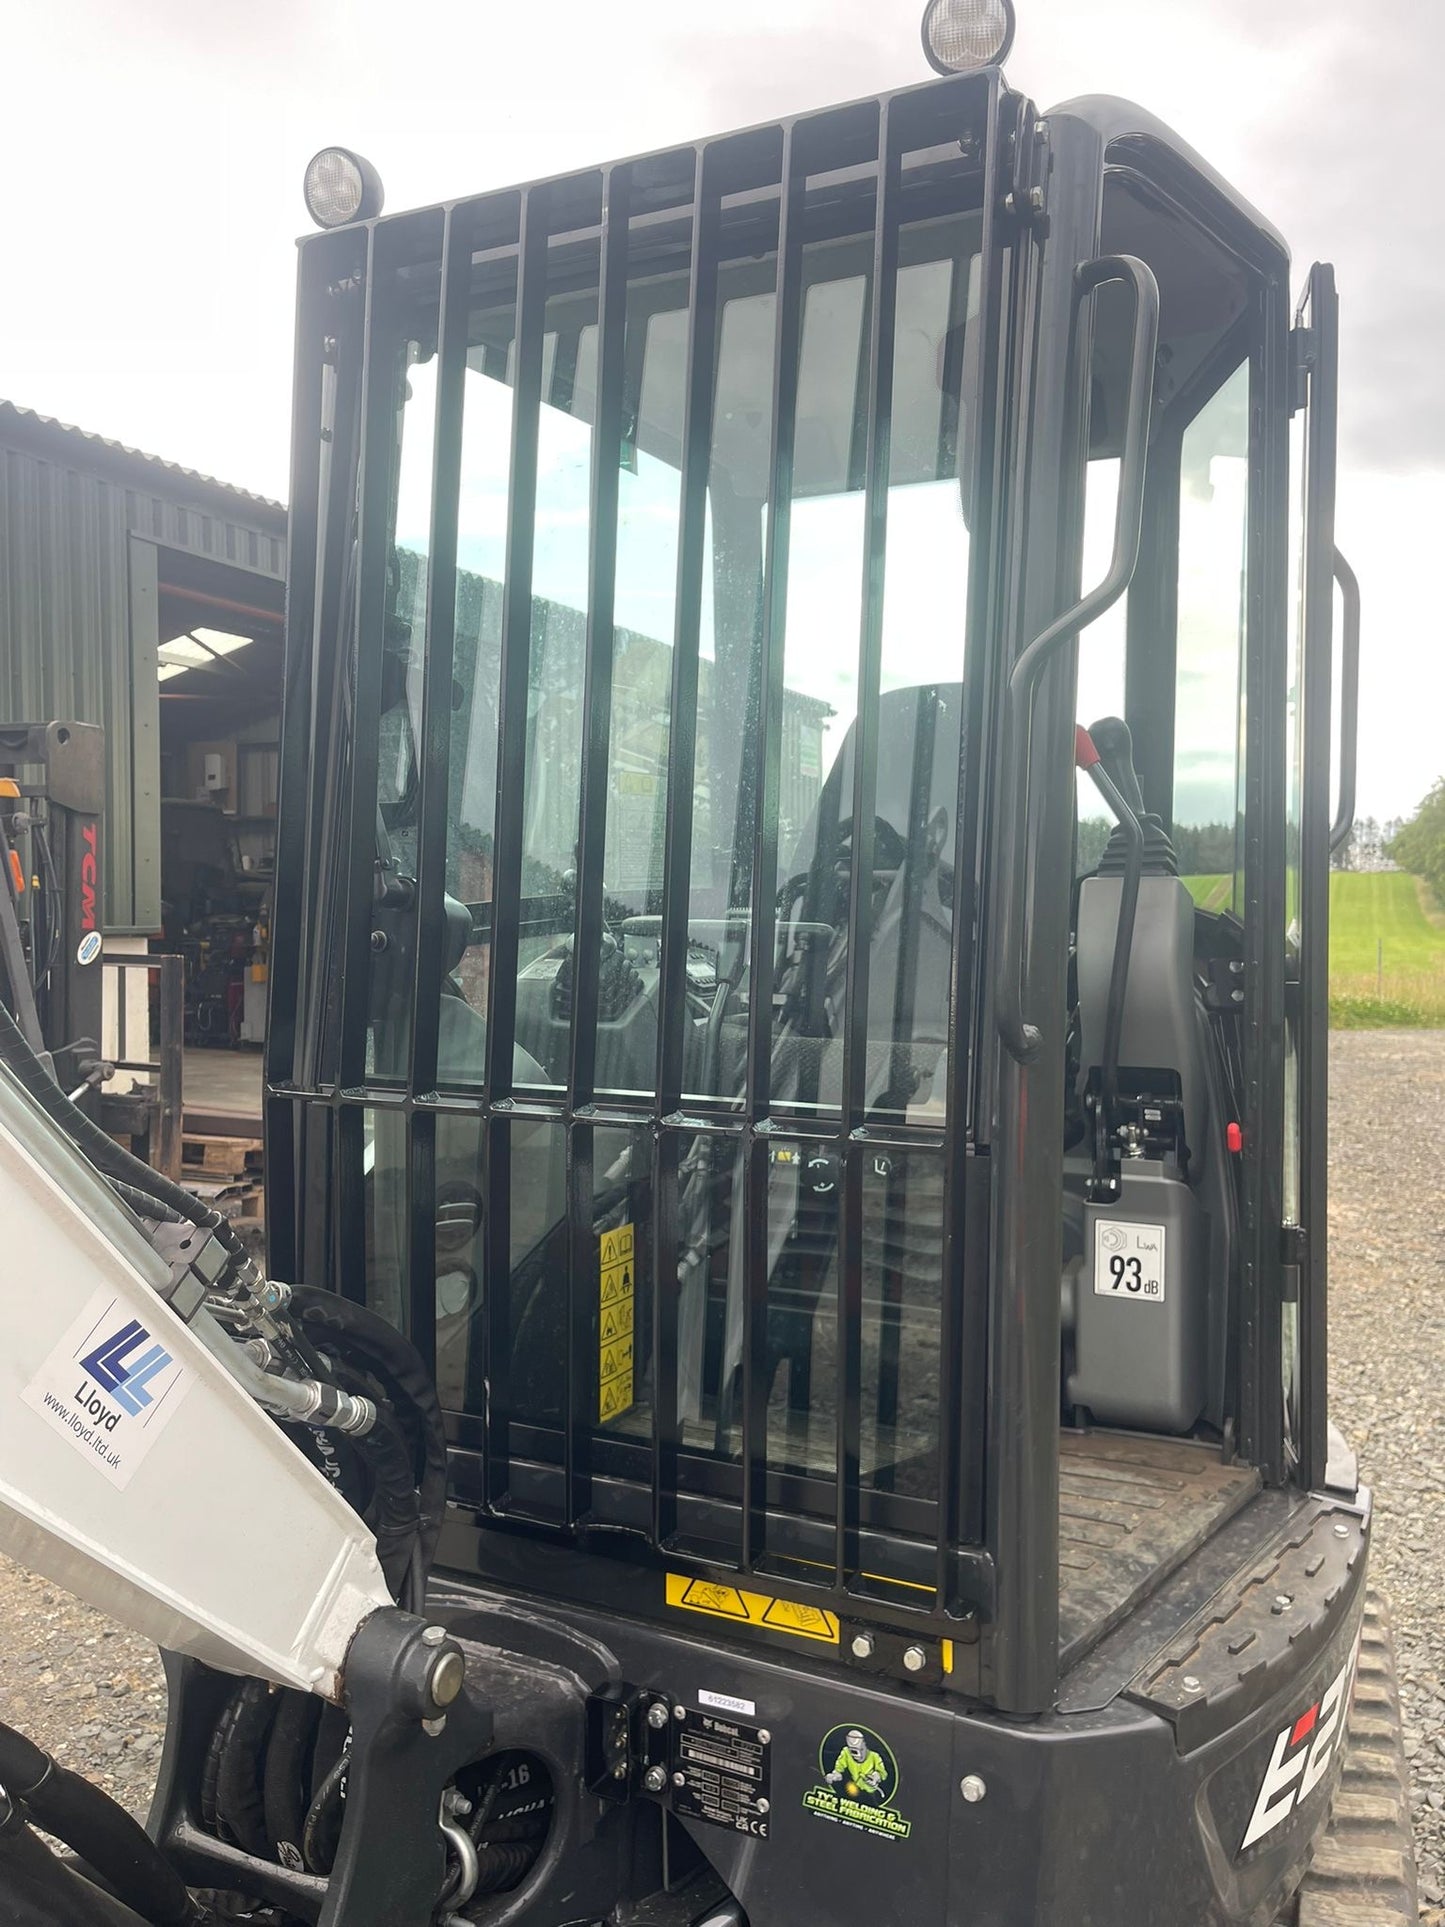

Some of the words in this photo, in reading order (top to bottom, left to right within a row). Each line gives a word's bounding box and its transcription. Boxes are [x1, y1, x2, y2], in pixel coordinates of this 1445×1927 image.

[81, 823, 96, 929] TCM
[1110, 1255, 1142, 1292] 93
[1144, 1280, 1159, 1295] dB
[74, 1381, 122, 1433] Lloyd
[43, 1392, 122, 1470] www.lloyd.ltd.uk
[750, 1821, 767, 1837] CE
[806, 1796, 838, 1812] STEEL
[839, 1807, 906, 1833] FABRICATION
[840, 1798, 886, 1818] WELDING
[886, 1812, 897, 1821] &
